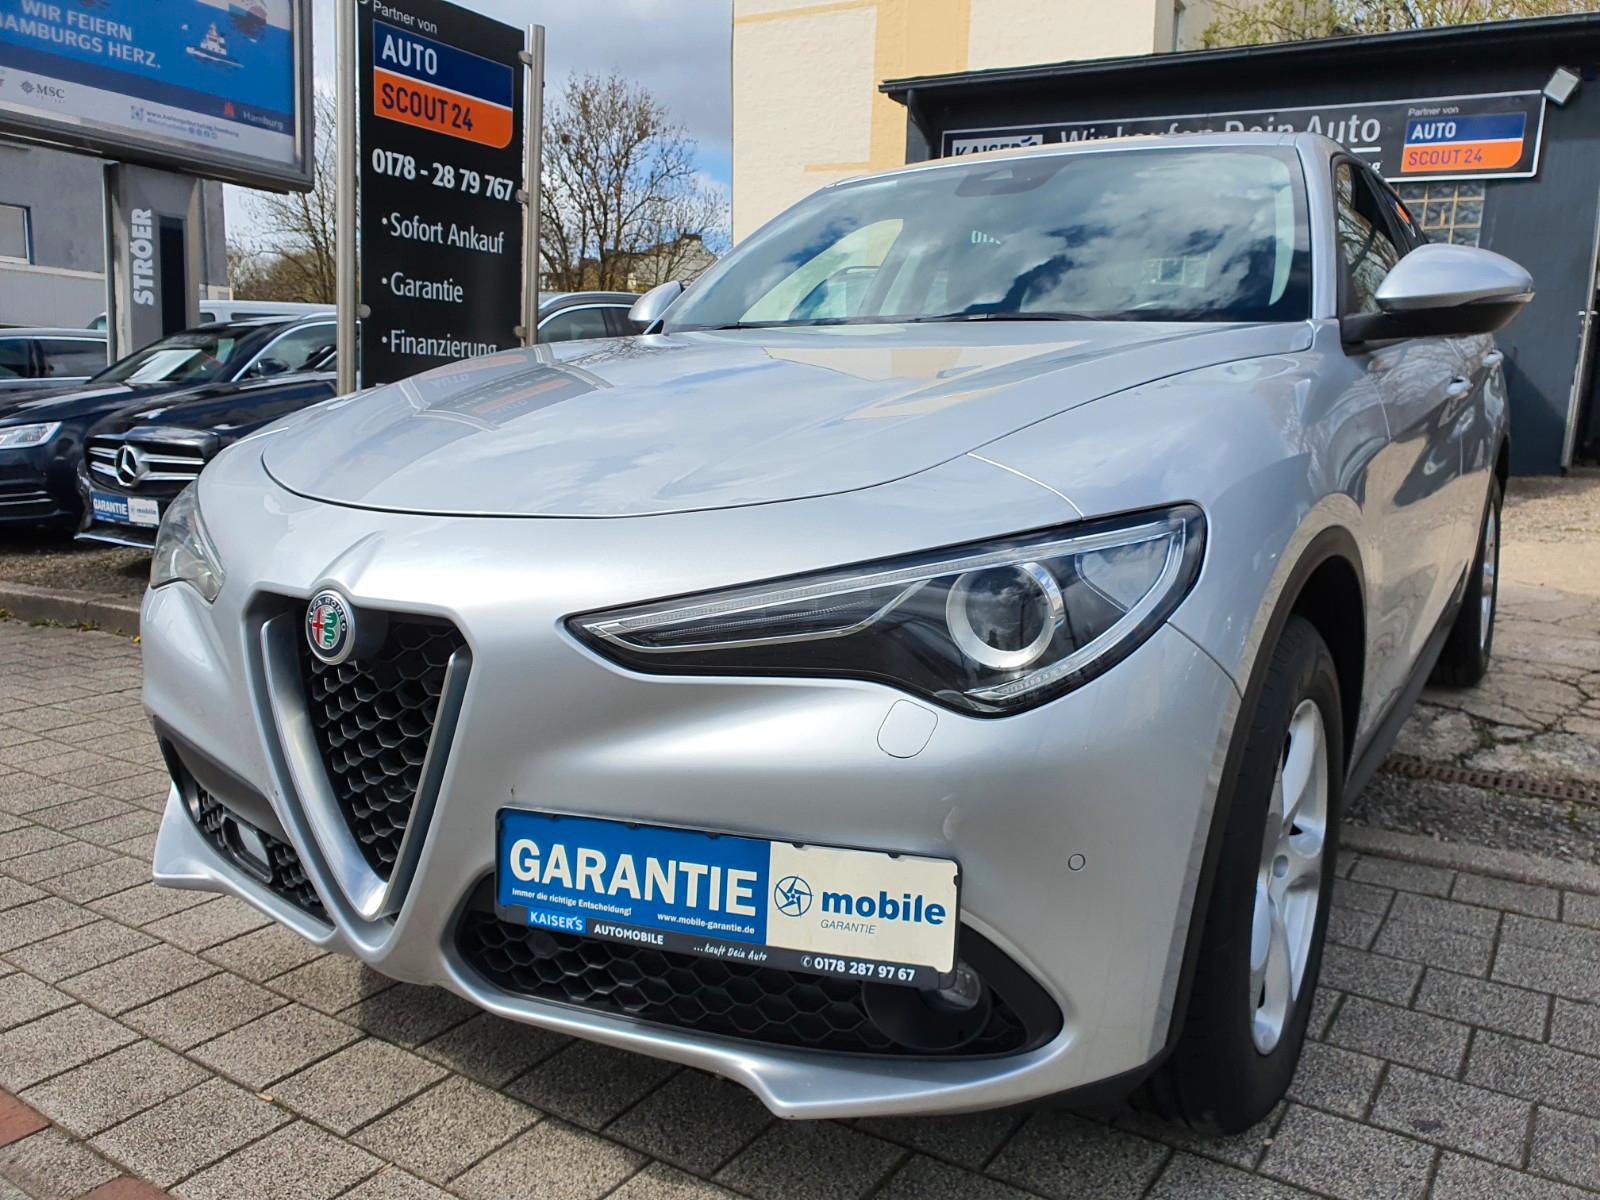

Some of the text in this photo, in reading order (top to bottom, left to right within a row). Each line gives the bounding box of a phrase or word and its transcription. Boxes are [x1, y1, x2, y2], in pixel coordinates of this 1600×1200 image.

[20, 0, 133, 41] WIR FEIERN
[373, 0, 437, 34] Partner von
[382, 34, 438, 76] AUTO
[36, 83, 65, 99] MSC
[243, 110, 284, 131] Hamburg
[1408, 106, 1459, 117] Partner von
[1307, 114, 1381, 144] Auto
[1411, 122, 1457, 140] AUTO
[372, 148, 416, 181] 0178
[432, 162, 455, 189] 28
[459, 168, 480, 194] 79
[484, 174, 514, 201] 767
[390, 212, 504, 254] Sofort Ankauf
[130, 208, 154, 306] STRÖER
[390, 271, 464, 303] Garantie
[390, 329, 498, 358] Finanzierung
[93, 498, 128, 516] GARANTIE
[509, 838, 758, 917] GARANTIE
[512, 888, 632, 916] Immer die richtige Entscheidung!
[820, 889, 946, 925] mobile
[594, 923, 664, 945] AUTOMOBILE
[657, 912, 755, 935] www.mobile-garantie.de
[820, 918, 876, 935] GARANTIE
[728, 947, 746, 959] Dein
[748, 949, 767, 961] Auto
[814, 957, 915, 982] 0178 287 97 67
